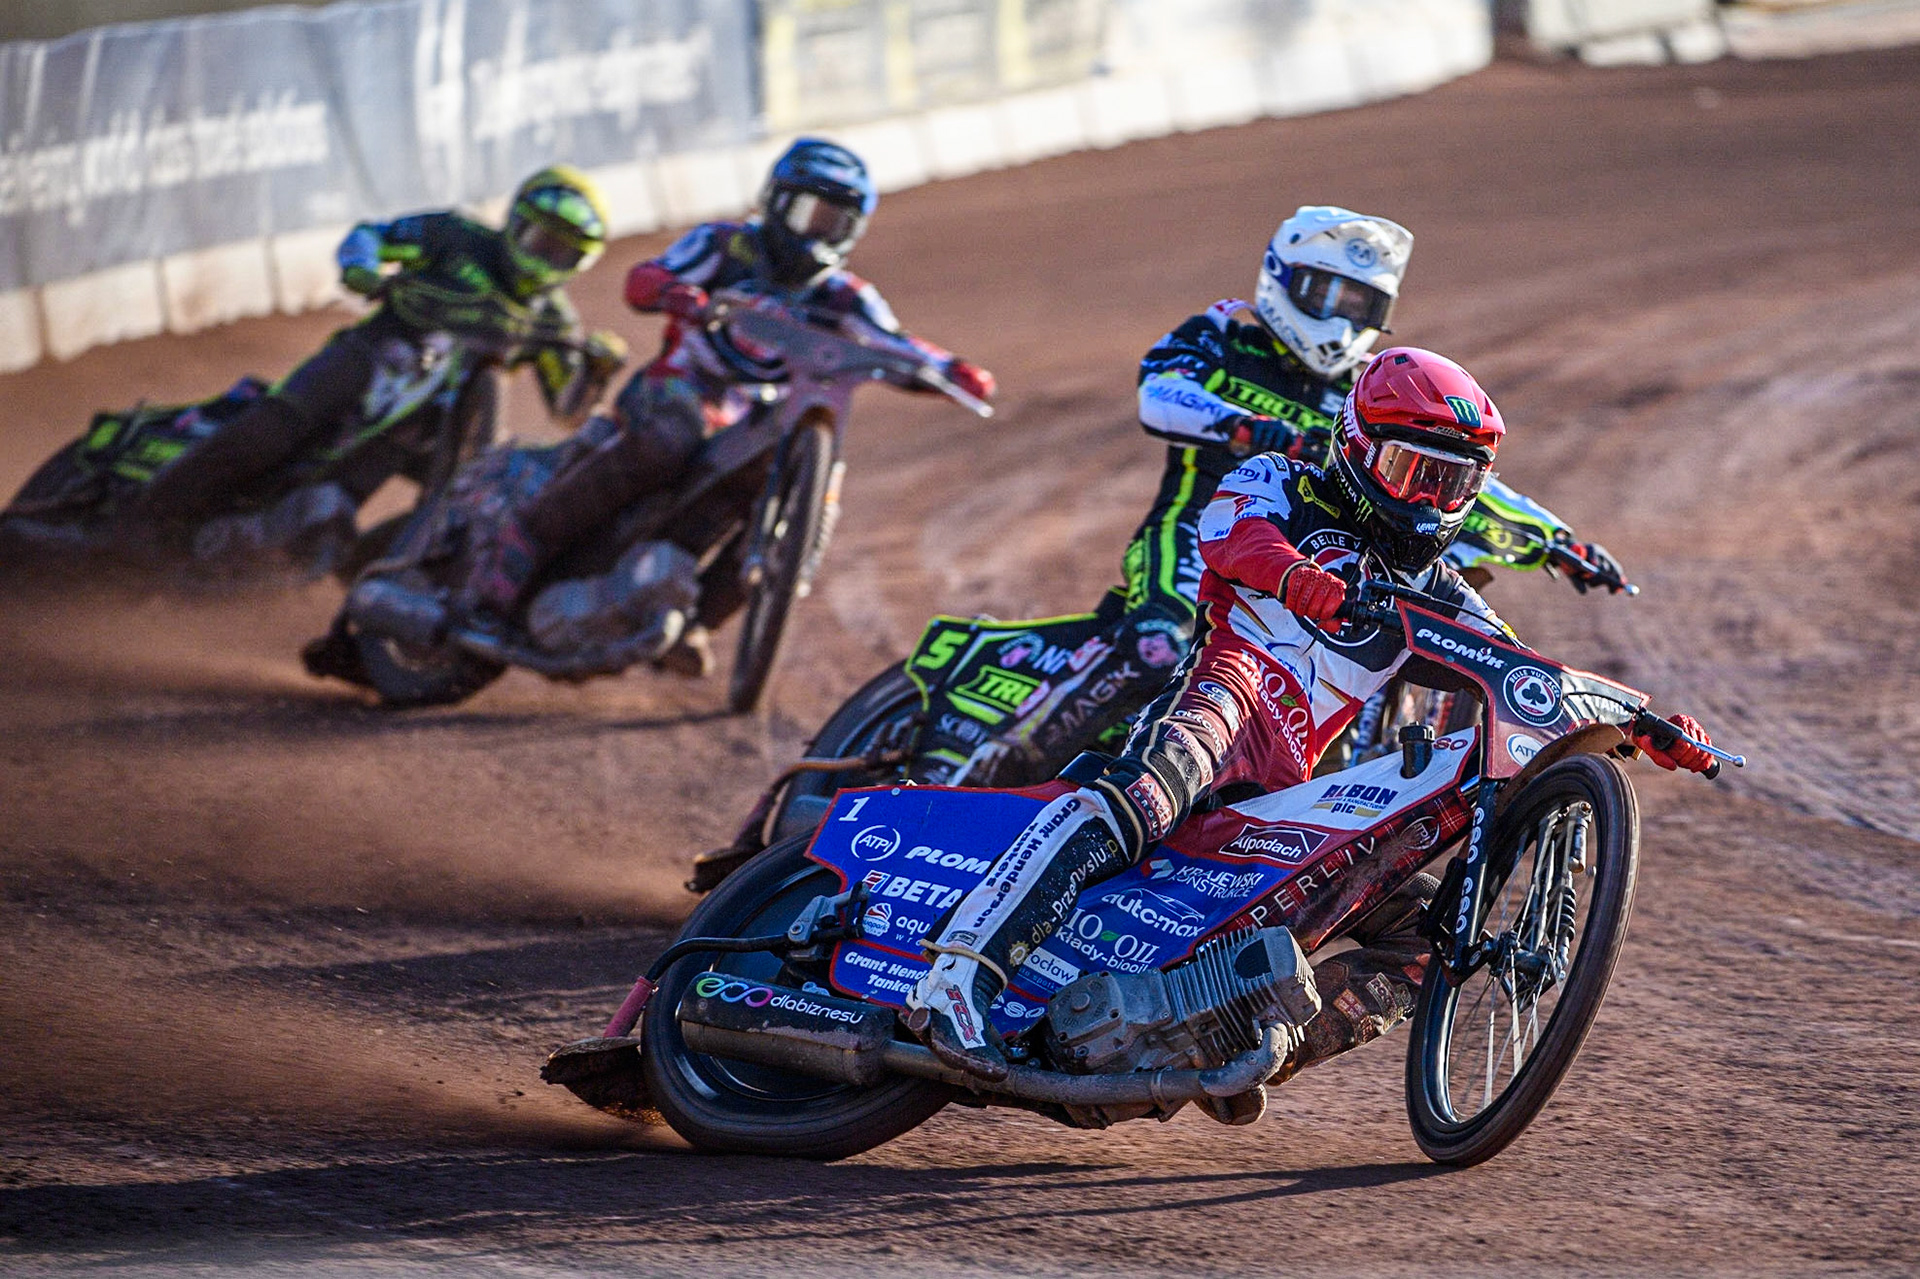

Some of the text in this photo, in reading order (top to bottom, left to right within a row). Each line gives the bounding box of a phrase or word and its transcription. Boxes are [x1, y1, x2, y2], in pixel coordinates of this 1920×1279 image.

[1310, 534, 1346, 550] BELLE
[916, 629, 970, 671] 5
[1508, 669, 1529, 684] BELLE
[1530, 670, 1547, 682] VUE
[1321, 784, 1400, 807] ALBON
[838, 797, 870, 822] 1
[858, 834, 894, 853] ATPI
[985, 822, 1039, 888] Tankers
[1230, 835, 1302, 859] Alpodach
[972, 798, 1082, 928] Grant Henderson
[1177, 865, 1265, 889] KRAJEWSKI
[881, 875, 964, 910] BETA
[1100, 893, 1206, 938] automax
[844, 950, 888, 973] Grant
[1113, 933, 1161, 965] OIL
[770, 994, 864, 1024] dlabiznesu
